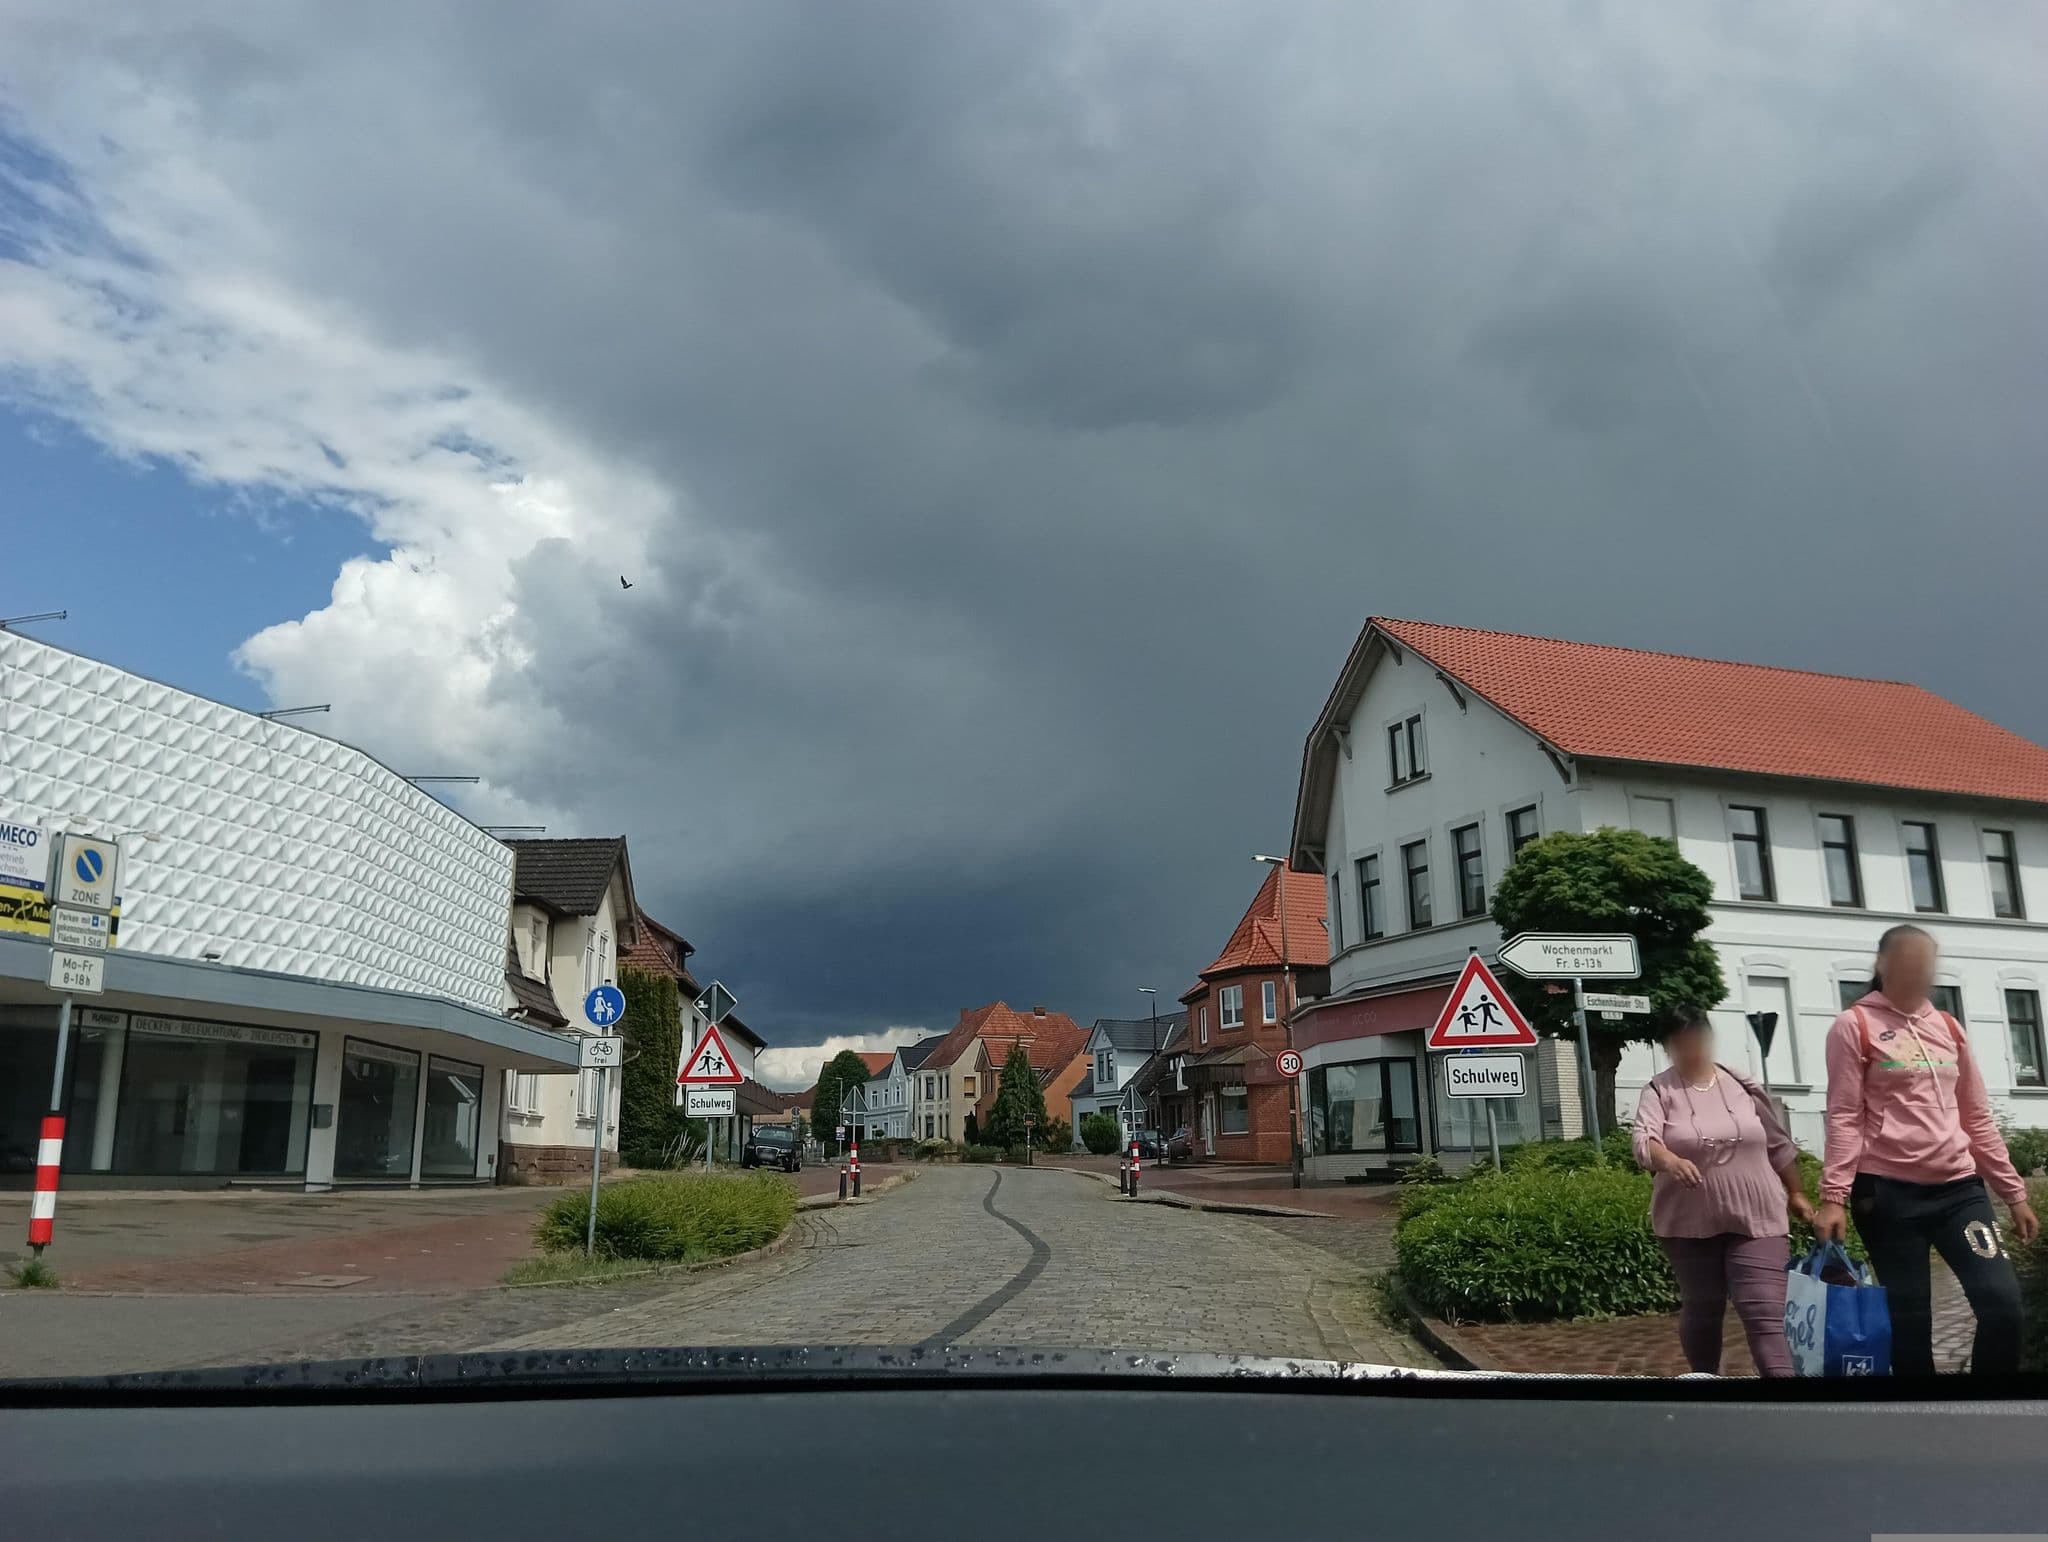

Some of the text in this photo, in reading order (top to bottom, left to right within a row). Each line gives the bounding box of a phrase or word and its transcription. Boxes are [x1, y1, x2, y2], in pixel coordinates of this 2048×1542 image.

[72, 889, 100, 905] ZONE
[1542, 944, 1613, 956] Wochenmarkt
[62, 957, 94, 972] Mo-Fr
[1556, 958, 1602, 969] Fr. 8-13h
[63, 972, 91, 986] 8-18h
[594, 1057, 608, 1065] frei
[1282, 1057, 1299, 1070] 30
[1452, 1068, 1519, 1087] Schulweg
[690, 1097, 732, 1111] Schulweg
